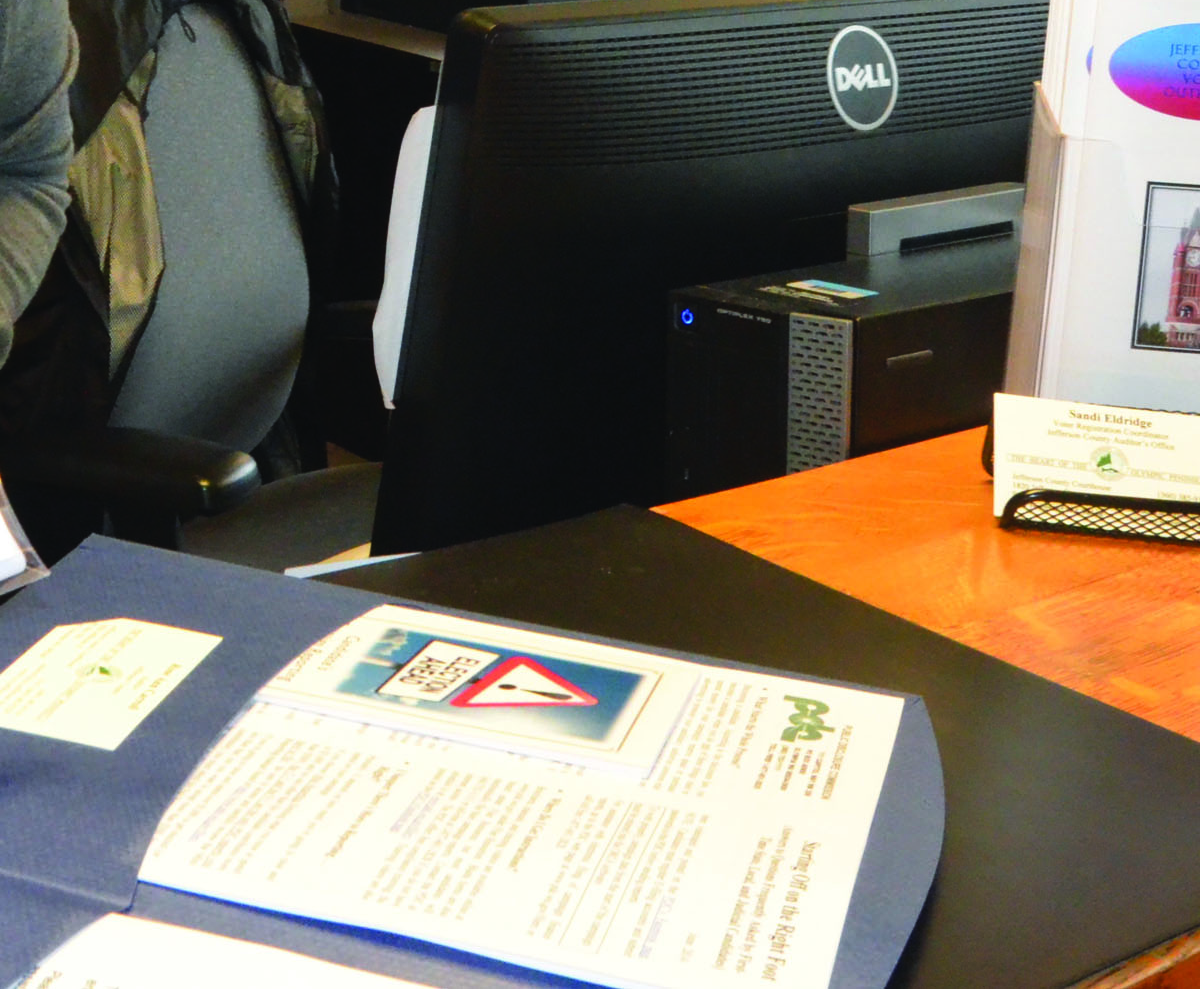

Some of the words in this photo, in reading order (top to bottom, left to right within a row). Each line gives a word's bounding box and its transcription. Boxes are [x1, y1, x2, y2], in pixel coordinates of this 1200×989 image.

[835, 63, 891, 92] DELL
[1069, 410, 1100, 422] Sandi
[1105, 414, 1152, 428] Eldridge
[1048, 430, 1080, 439] Jefferson
[1084, 433, 1111, 443] County
[1114, 437, 1148, 447] Auditor's
[1151, 440, 1175, 450] Office
[399, 656, 446, 685] AHEAD
[420, 656, 480, 694] ELECTION
[780, 695, 836, 742] pdc
[791, 841, 821, 873] Starting
[789, 873, 810, 892] Off
[785, 890, 800, 903] on
[779, 905, 800, 921] the
[770, 923, 795, 954] Right
[762, 956, 786, 982] Foot
